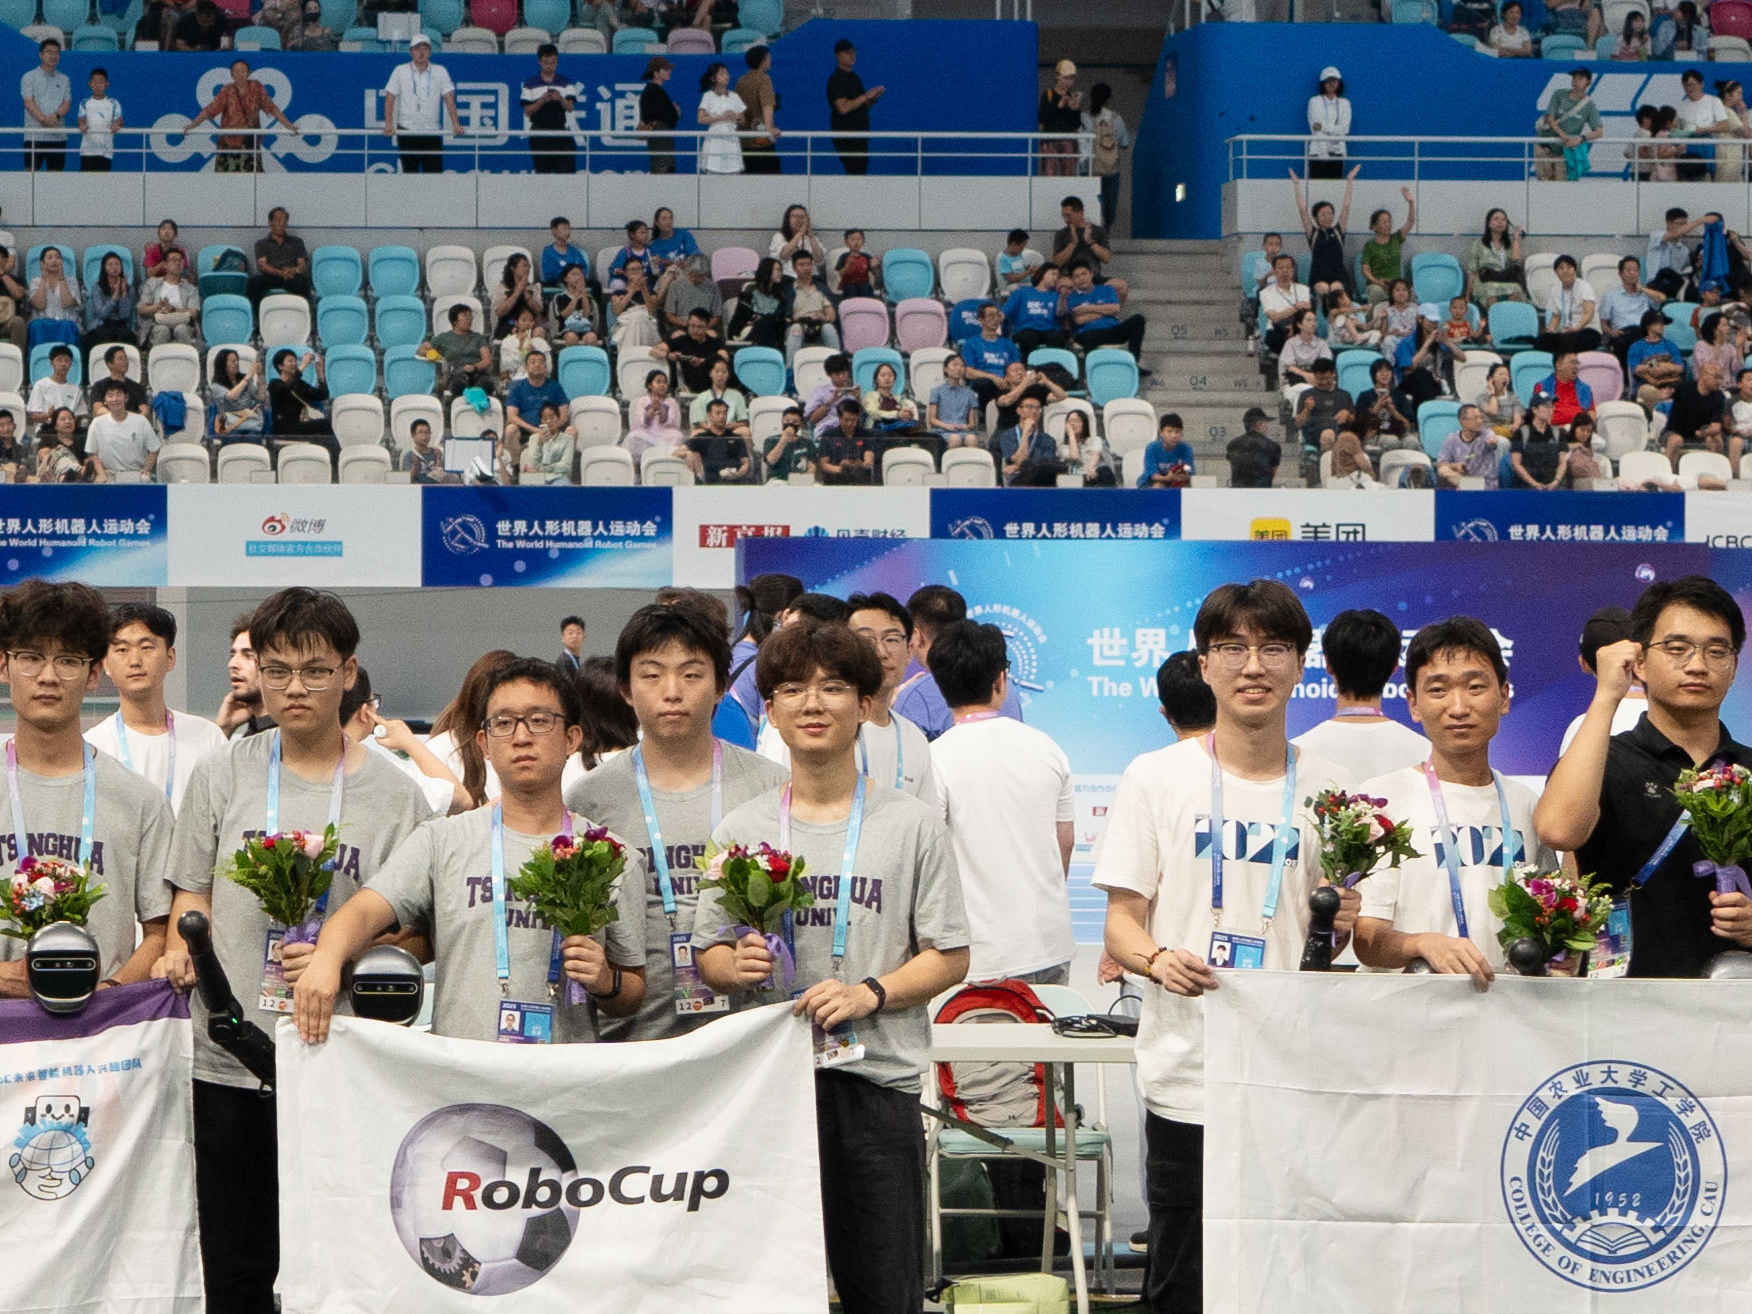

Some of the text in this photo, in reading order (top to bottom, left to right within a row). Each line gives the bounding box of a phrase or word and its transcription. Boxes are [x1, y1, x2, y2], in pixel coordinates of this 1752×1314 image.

[290, 517, 326, 535] 微博
[496, 520, 658, 537] 世界人形机器人运动会
[1087, 677, 1132, 698] The
[1513, 1064, 1712, 1145] 中国农业大学工学院
[441, 1165, 731, 1213] RoboCup
[1594, 1191, 1642, 1208] 1952
[1509, 1176, 1556, 1258] COLLEGE
[1557, 1255, 1583, 1277] OF
[1700, 1180, 1719, 1218] CAU
